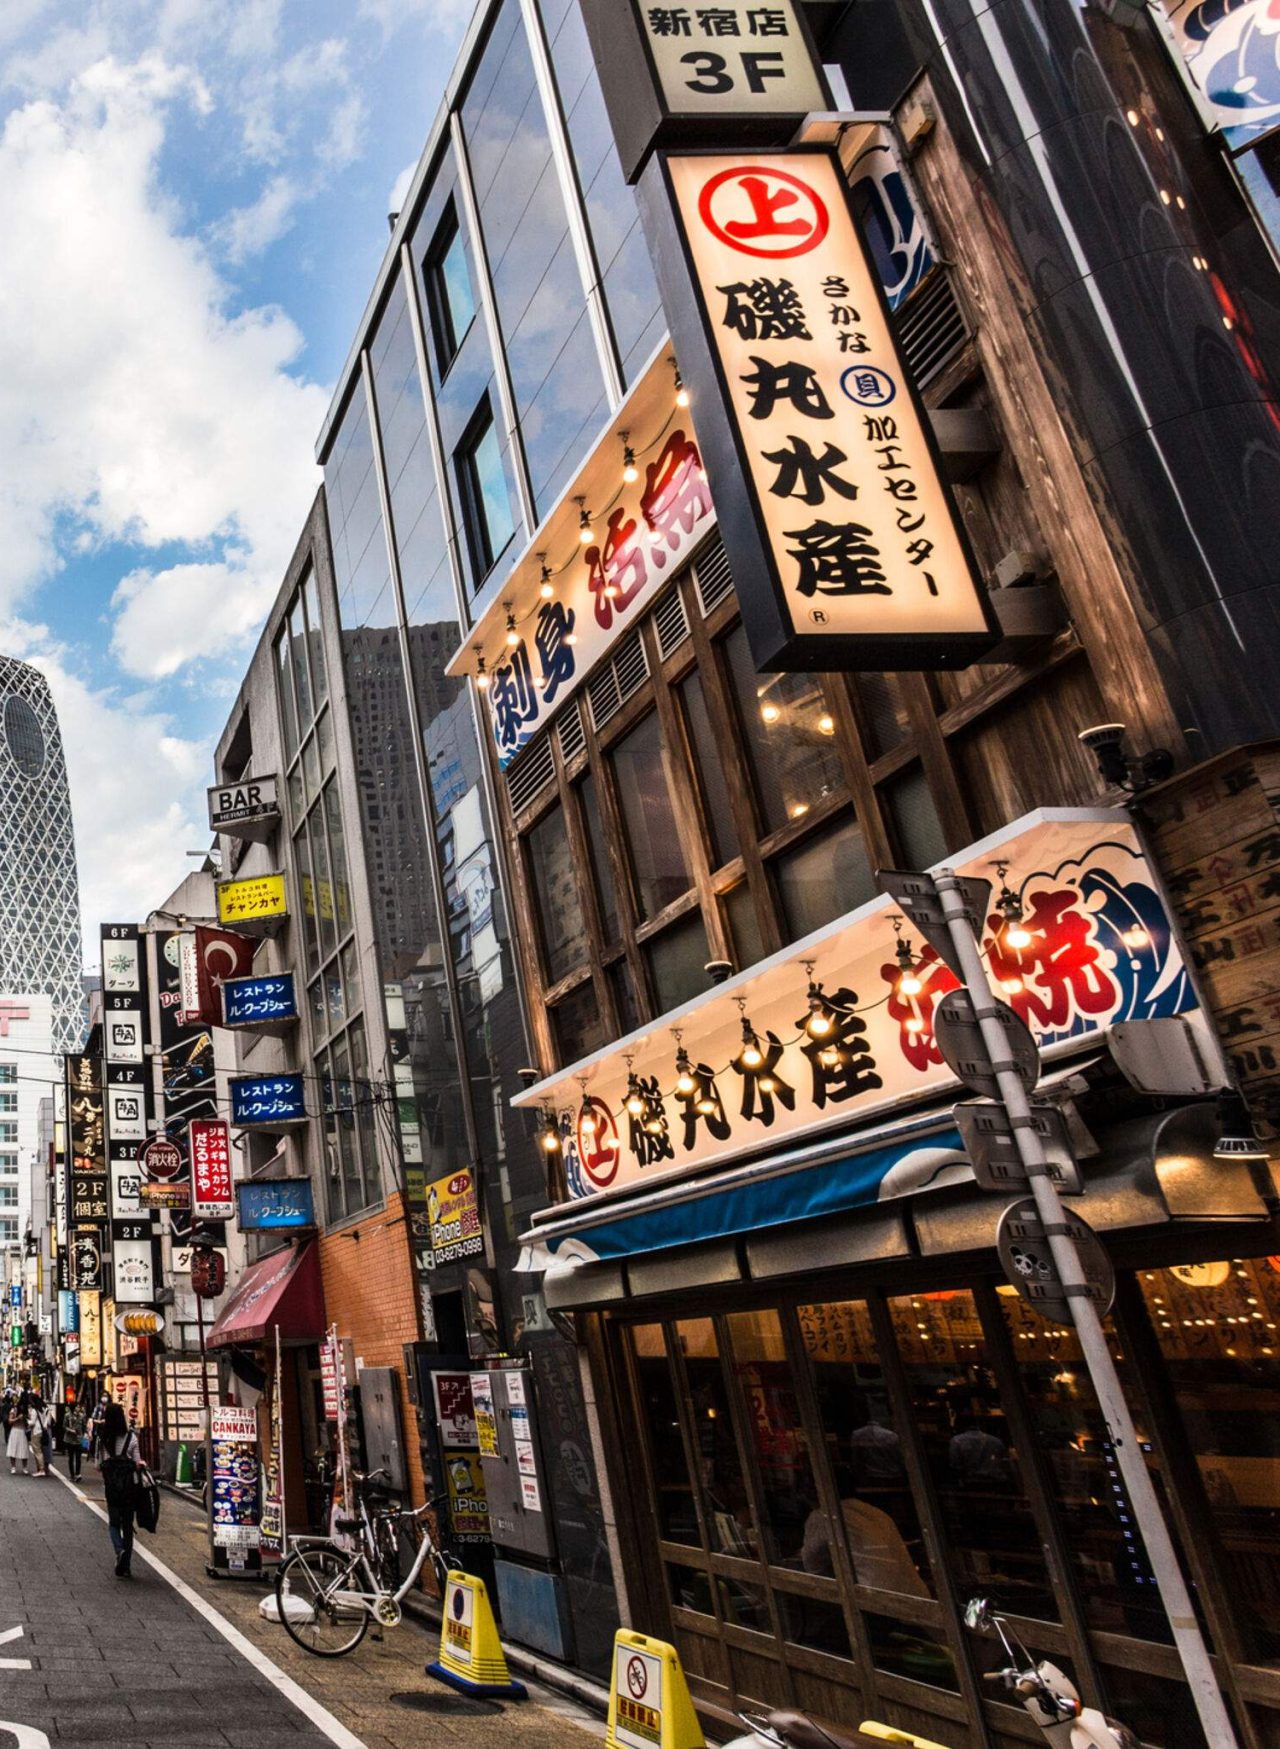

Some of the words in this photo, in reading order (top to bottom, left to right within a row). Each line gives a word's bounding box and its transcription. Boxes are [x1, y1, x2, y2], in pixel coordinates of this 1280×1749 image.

[649, 5, 789, 38] 新宿店
[684, 51, 788, 95] 3F
[724, 176, 816, 240] 上
[717, 276, 892, 599] 磯丸水産
[219, 786, 262, 811] BAR
[221, 809, 250, 821] HERMIT
[225, 896, 281, 914] チャンカヤ
[109, 980, 135, 988] ダーツ
[233, 982, 285, 999] レストラン
[629, 984, 883, 1168] 磯丸水産
[241, 1083, 295, 1098] レストラン
[148, 1152, 178, 1167] 消火栓
[195, 1134, 210, 1192] だるまや
[209, 1128, 221, 1196] ジンギスカン
[150, 1192, 176, 1200] iPhone
[75, 1202, 107, 1218] 個室
[432, 1221, 461, 1246] iPhone
[78, 1238, 97, 1286] 清香苑
[213, 1408, 256, 1418] トルコ料理
[453, 1498, 488, 1513] iPho
